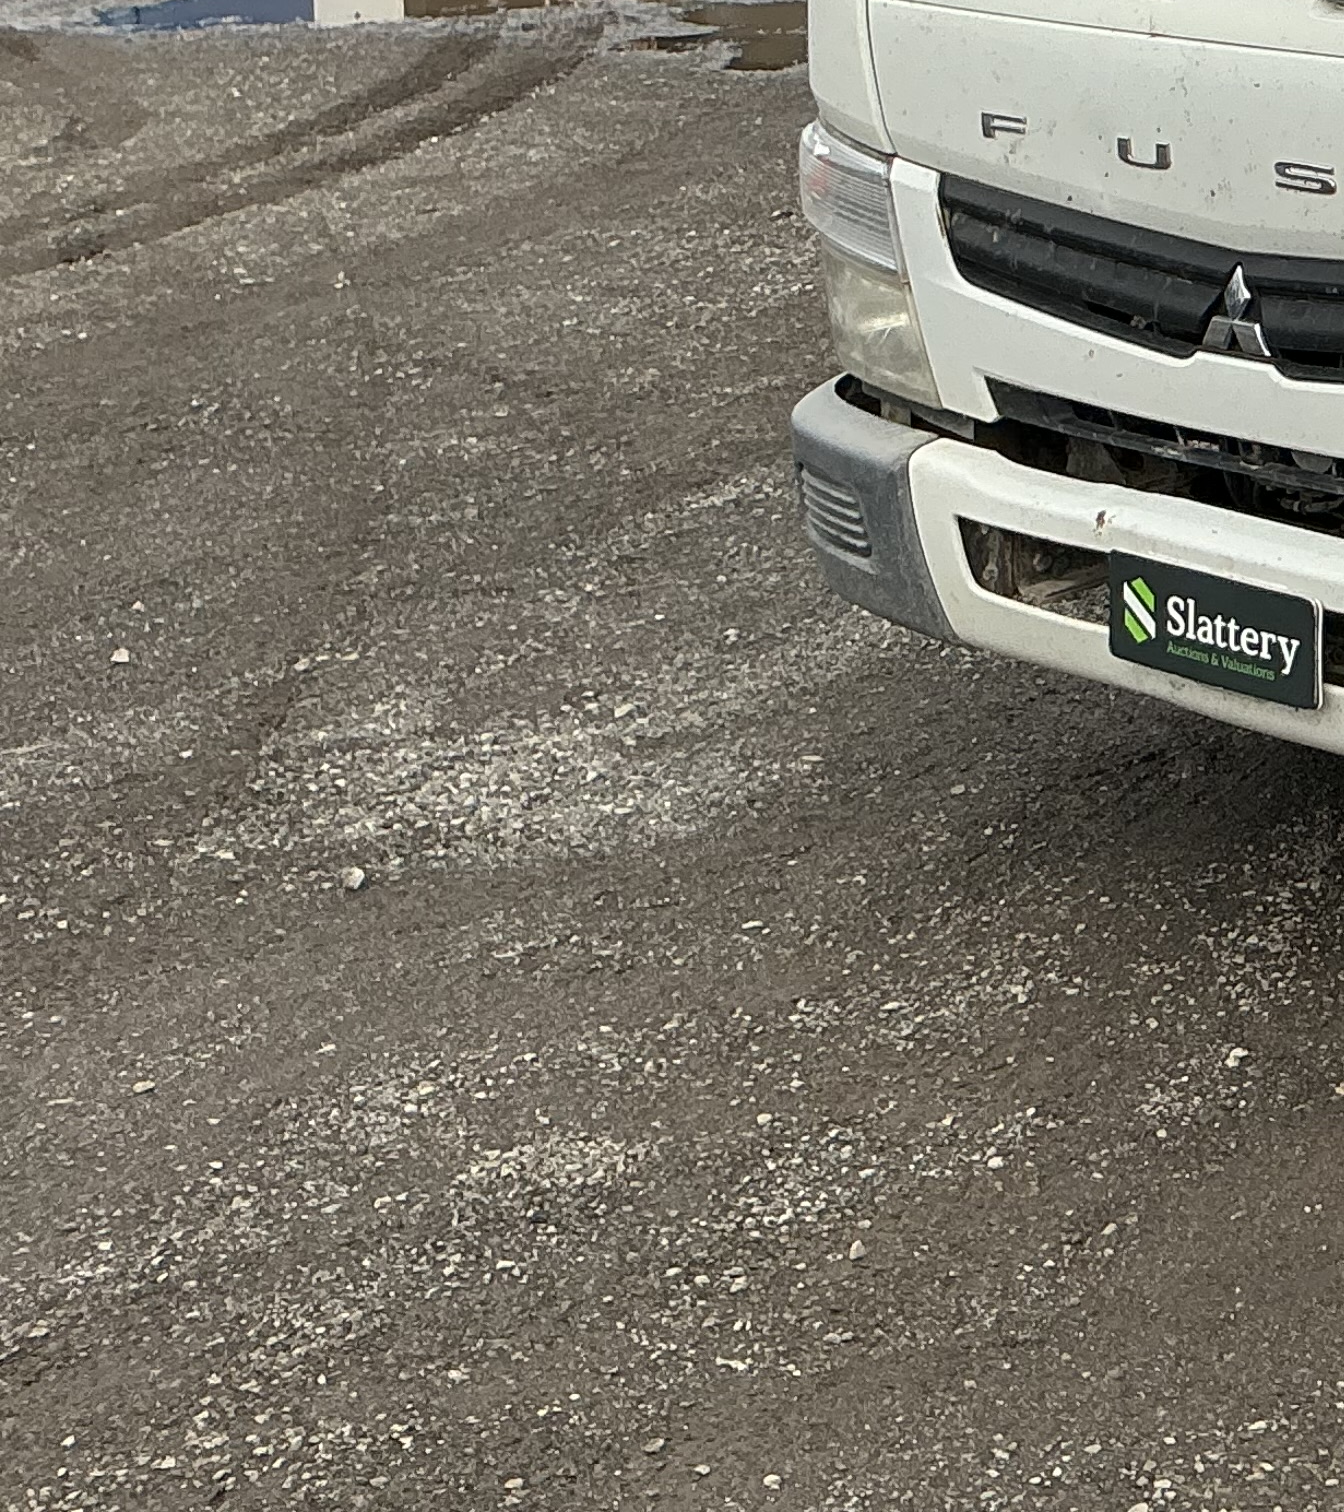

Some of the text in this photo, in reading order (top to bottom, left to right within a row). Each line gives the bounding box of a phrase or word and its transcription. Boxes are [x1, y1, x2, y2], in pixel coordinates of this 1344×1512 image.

[1166, 595, 1301, 676] Slattery
[1166, 640, 1276, 682] Auctions & Valuations
